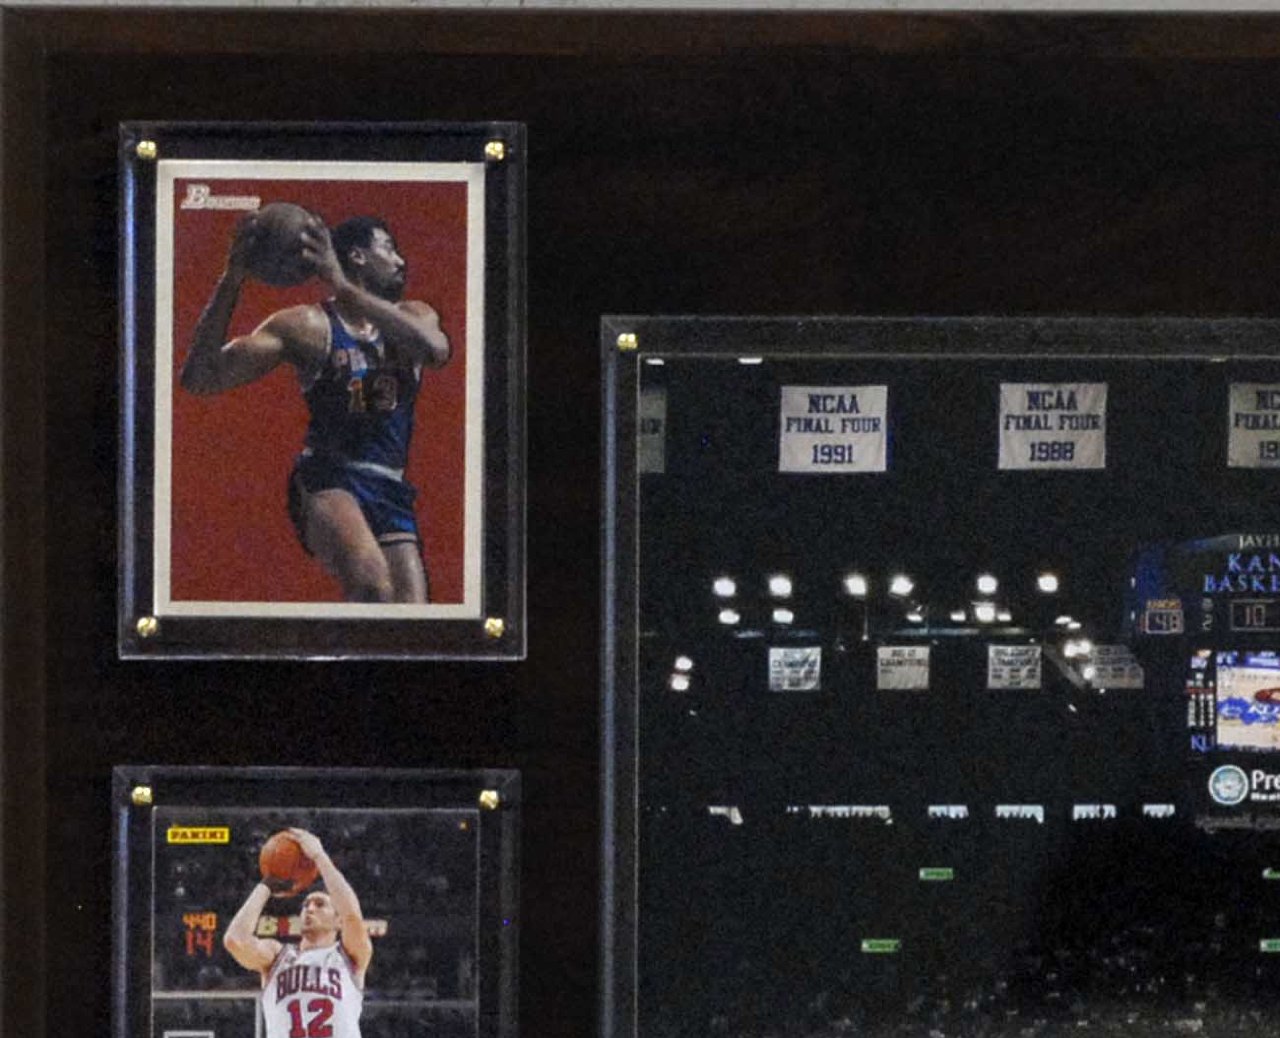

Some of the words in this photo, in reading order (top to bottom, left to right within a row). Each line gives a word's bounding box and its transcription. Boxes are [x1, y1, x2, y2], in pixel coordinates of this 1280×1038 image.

[808, 394, 860, 413] NCAA
[1027, 391, 1077, 410] NCAA
[785, 417, 833, 433] FINAL
[841, 417, 881, 433] FOUR
[1004, 414, 1052, 430] FINAL
[1059, 414, 1101, 430] FOUR
[812, 445, 853, 464] 1991
[171, 829, 226, 840] PANINI
[276, 965, 342, 1003] BULLS
